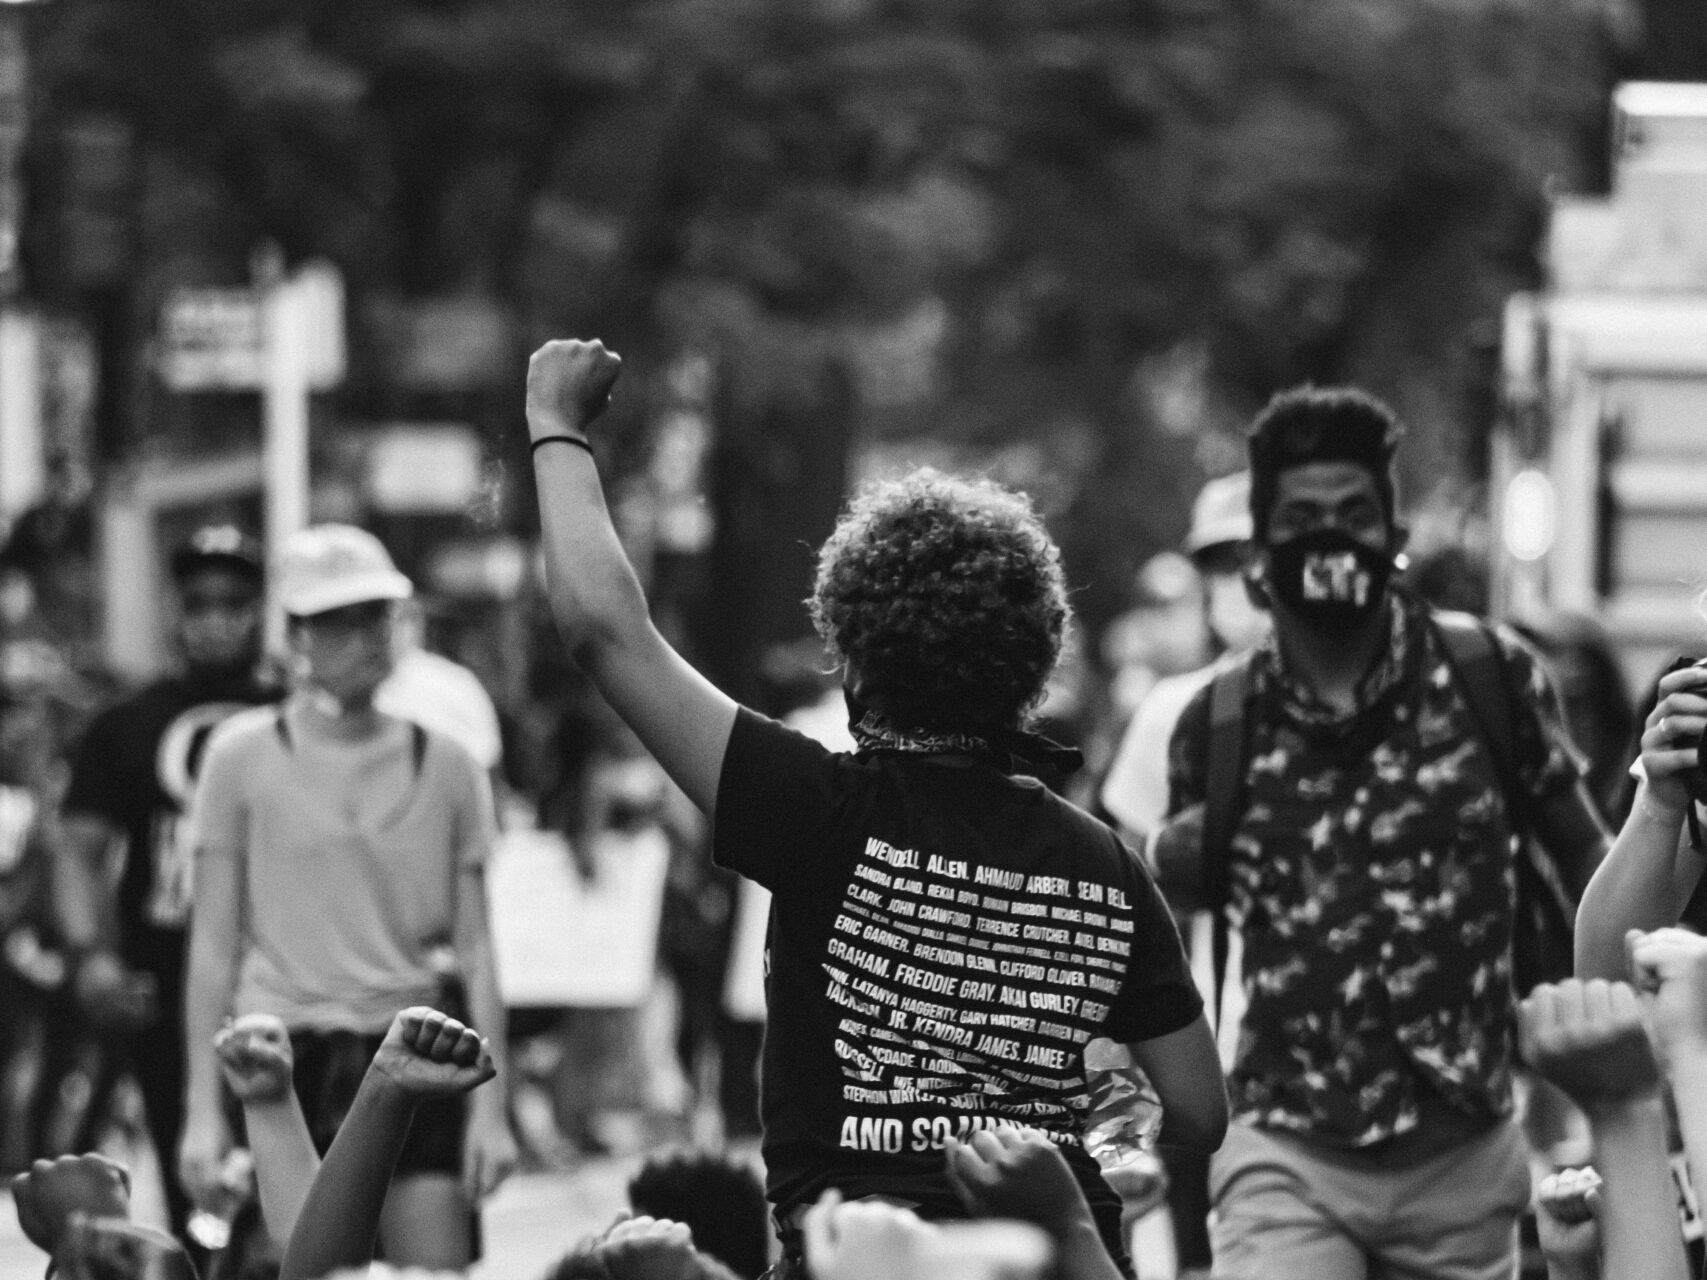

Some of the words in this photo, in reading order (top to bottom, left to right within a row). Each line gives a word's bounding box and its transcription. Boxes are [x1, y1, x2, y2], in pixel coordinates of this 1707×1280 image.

[854, 864, 892, 888] SANDRA
[927, 884, 955, 901] REKIA
[865, 837, 920, 870] WENDELL
[974, 865, 1025, 891] AHMAUD
[1078, 880, 1103, 903] SEAN
[846, 883, 883, 908] CLARK.
[886, 898, 917, 917] JOHN
[918, 904, 972, 928] CRAWFORD.
[976, 917, 1021, 938] TERRENCE
[827, 938, 890, 978] GRAHAM.
[894, 963, 959, 996] FREDDIE
[959, 980, 997, 1002] GRAY.
[999, 985, 1027, 1008] AKAI
[1029, 991, 1080, 1015] GURLEY.
[834, 914, 863, 936] ERIC
[863, 925, 910, 953] GARNER.
[913, 943, 965, 967] BRENDON
[1000, 960, 1046, 981] CLIFFORD
[1046, 967, 1088, 987] GLOVER.
[851, 977, 899, 1007] LATANYA
[900, 997, 958, 1022] HAGGERTY.
[959, 1010, 988, 1025] GARY
[887, 1009, 909, 1030] JR.
[912, 1016, 974, 1048] KENDRA
[973, 1034, 1021, 1061] JAMES.
[1023, 1045, 1066, 1070] JAMEE
[843, 1085, 888, 1104] STEPHON
[840, 1116, 904, 1153] AND
[911, 1116, 952, 1151] SO
